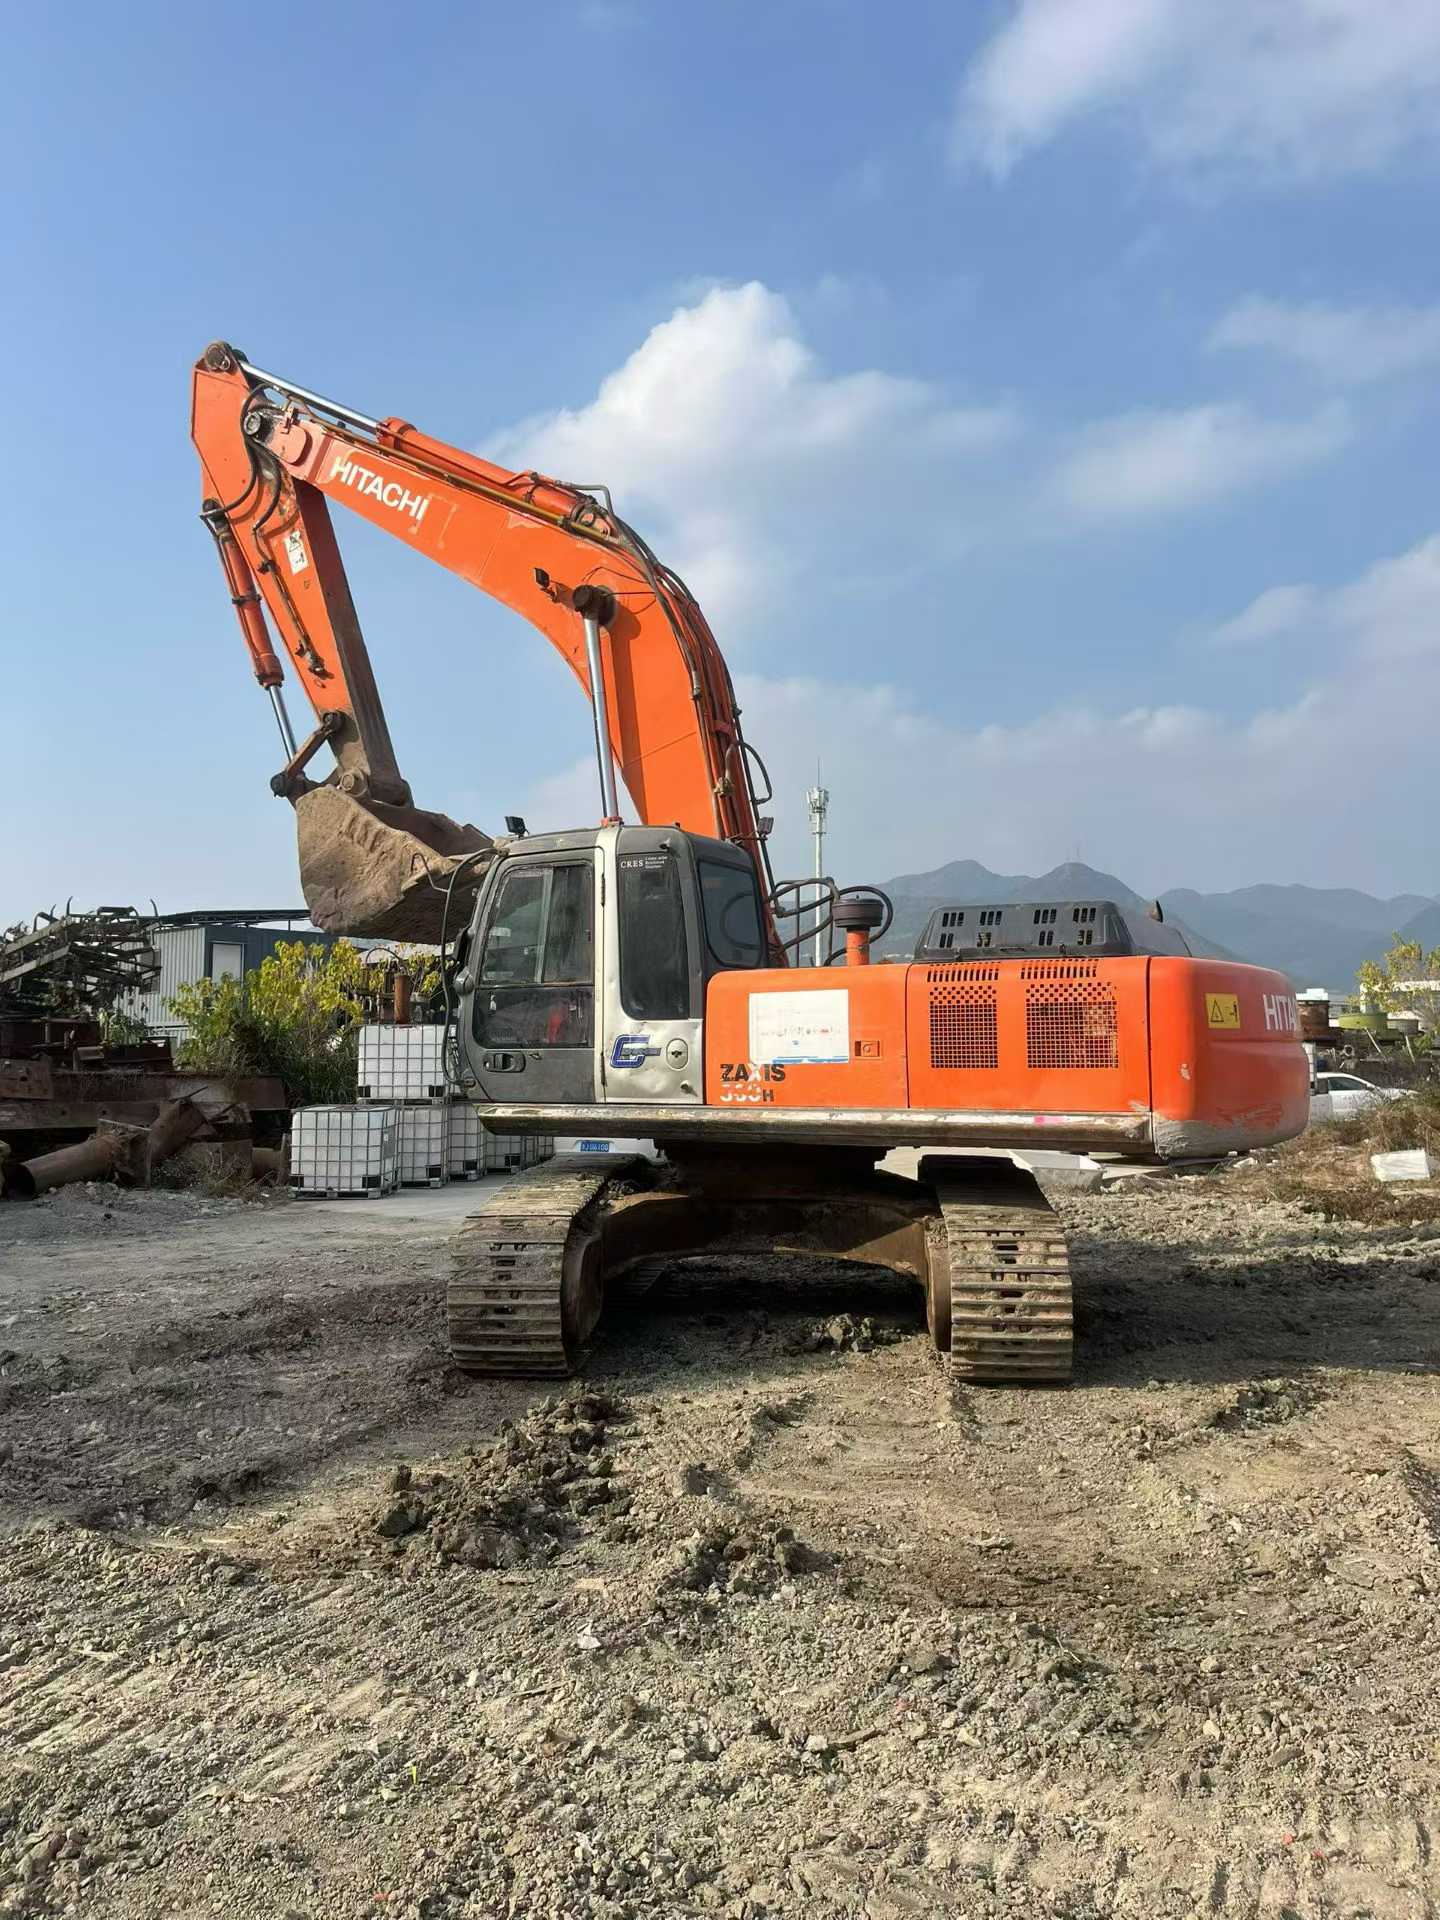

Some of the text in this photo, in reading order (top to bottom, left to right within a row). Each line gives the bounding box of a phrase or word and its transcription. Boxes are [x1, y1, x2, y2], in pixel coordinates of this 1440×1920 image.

[329, 456, 430, 521] HITACHI
[620, 859, 644, 869] CRES
[719, 1063, 786, 1082] ZAXIS
